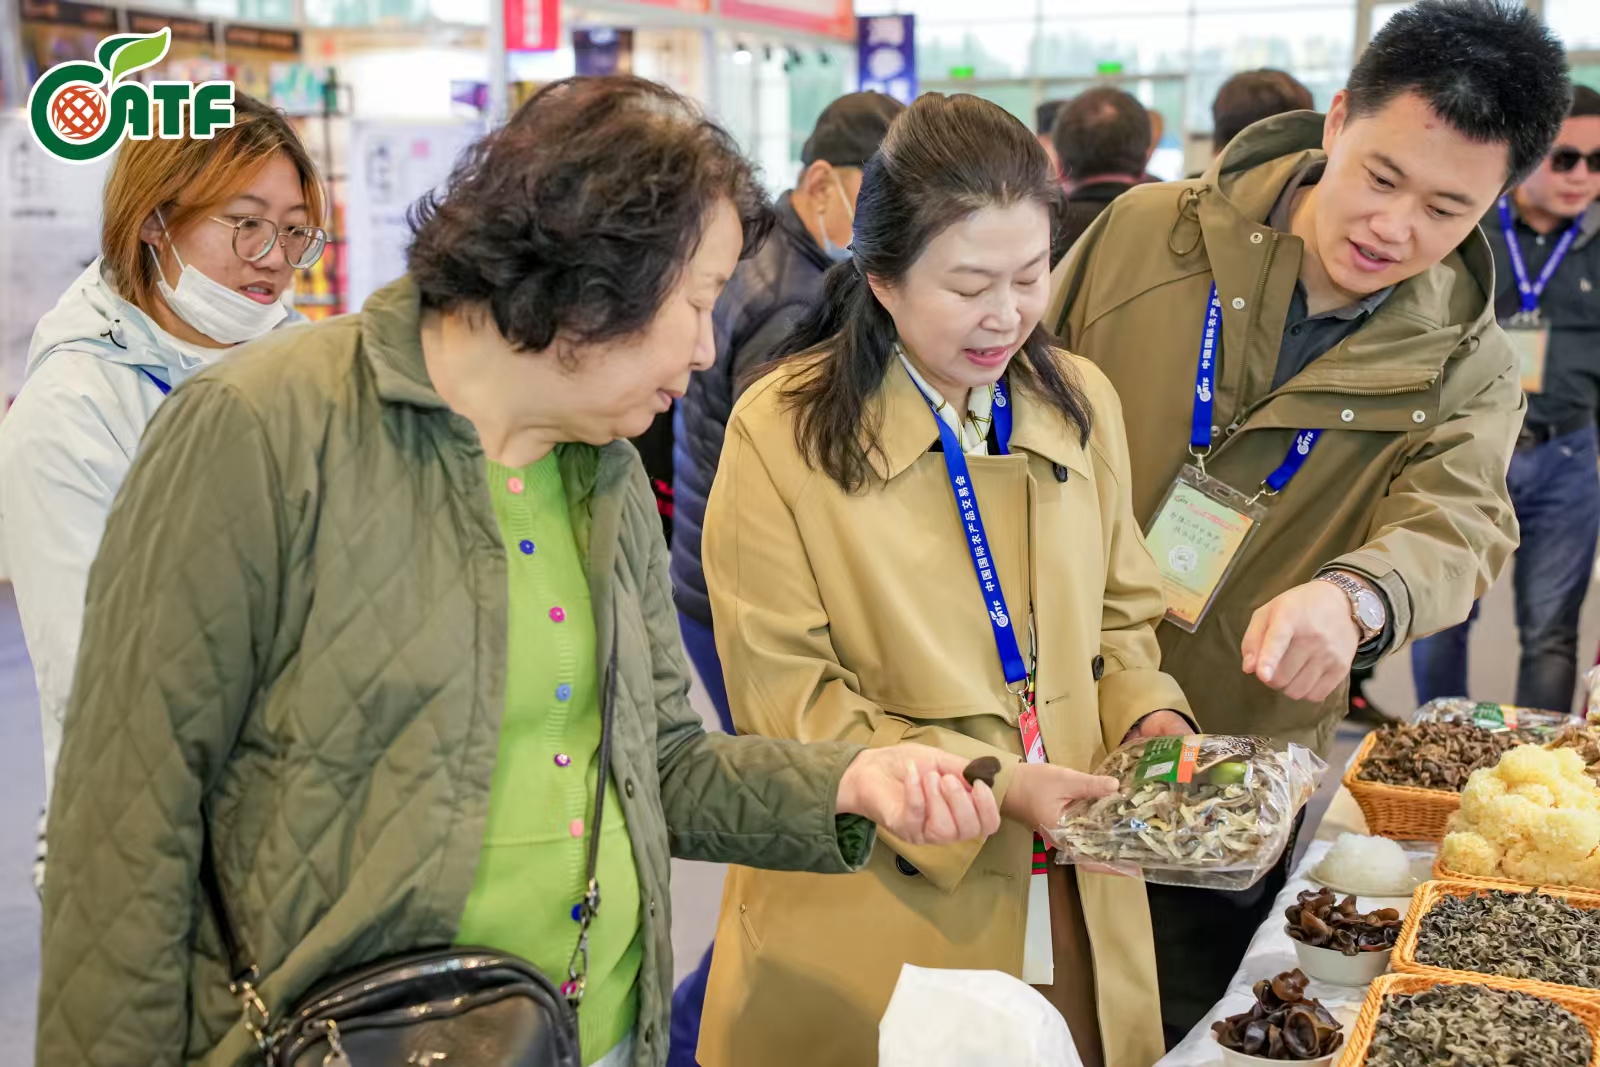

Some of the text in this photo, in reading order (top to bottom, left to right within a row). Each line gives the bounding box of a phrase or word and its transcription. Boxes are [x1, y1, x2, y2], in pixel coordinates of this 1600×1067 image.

[1201, 289, 1221, 369] 中国国际农产品
[955, 475, 996, 592] 中国国际农产品交易会
